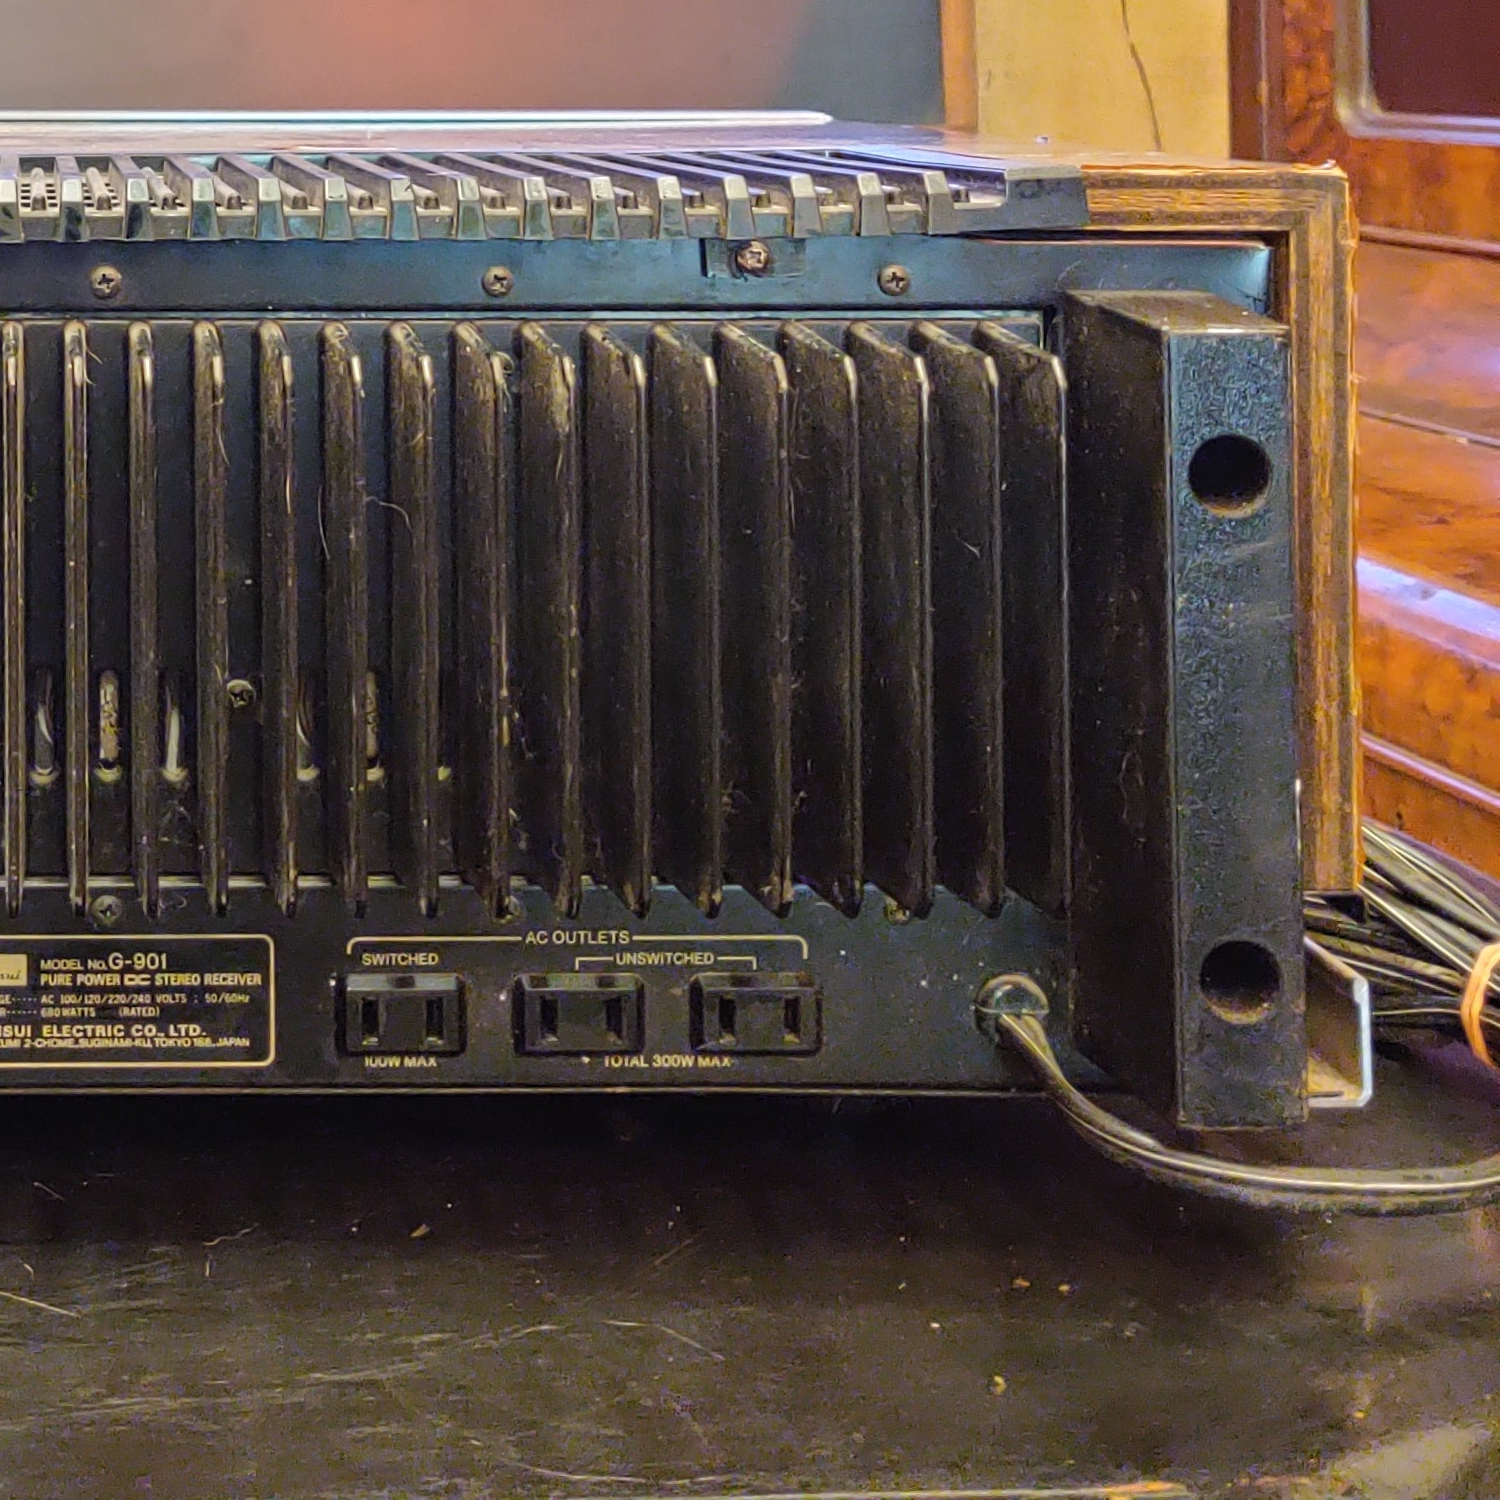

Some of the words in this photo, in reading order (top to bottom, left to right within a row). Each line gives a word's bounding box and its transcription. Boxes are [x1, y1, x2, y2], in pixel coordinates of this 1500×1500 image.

[526, 931, 548, 944] AC
[552, 931, 630, 944] OUTLETS
[40, 958, 84, 970] MODEL
[108, 952, 167, 970] G-901
[362, 953, 439, 966] SWITCHED
[615, 952, 715, 966] UNSWITCHED
[40, 973, 73, 986] PURE
[76, 973, 121, 986] POWER
[124, 973, 151, 986] DC
[155, 973, 200, 986] STEREO
[204, 973, 262, 986] RECEIVER
[42, 1025, 124, 1038] ELECTRIC
[169, 1024, 207, 1037] LTD.
